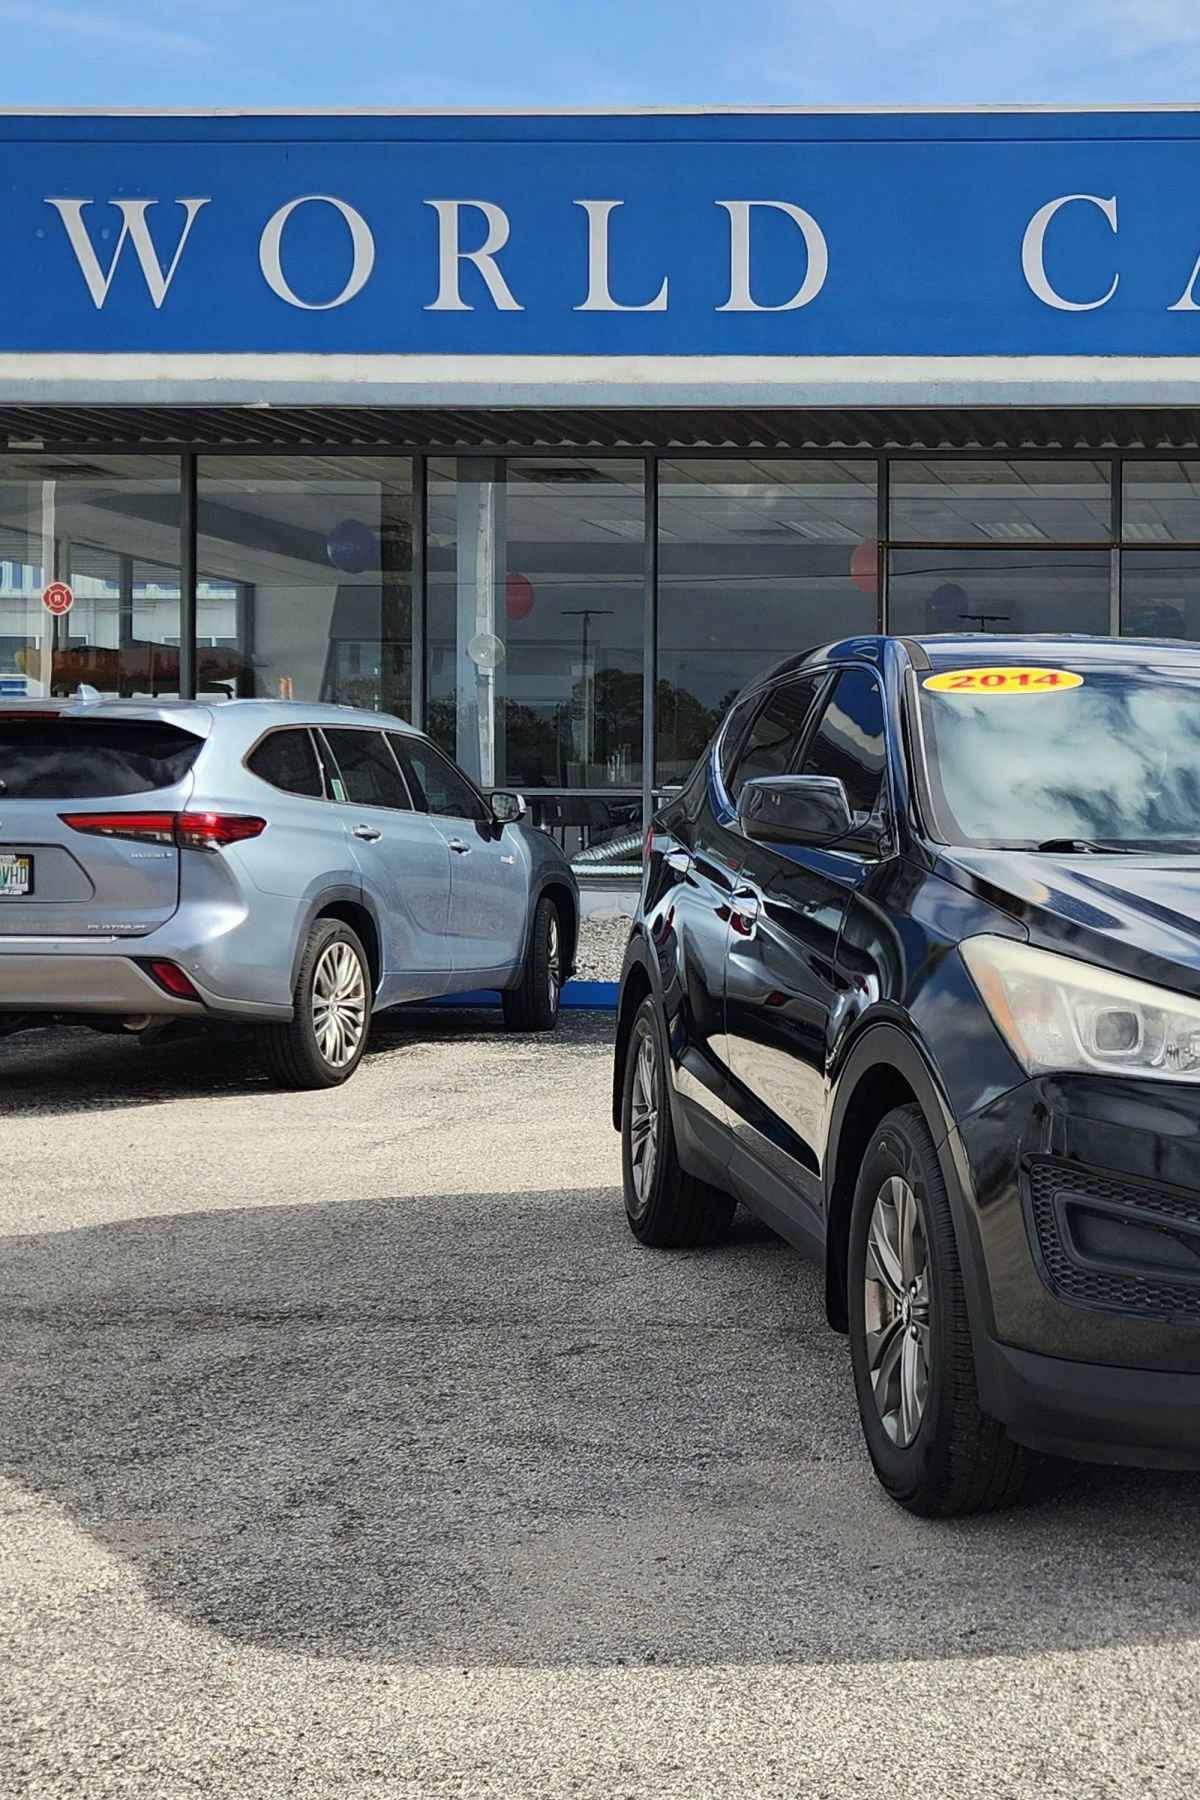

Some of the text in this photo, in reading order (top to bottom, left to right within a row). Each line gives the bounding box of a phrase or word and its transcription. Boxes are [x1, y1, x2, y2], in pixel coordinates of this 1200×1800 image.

[43, 194, 828, 311] WORLD
[949, 674, 1061, 688] 2014
[0, 865, 28, 885] VHD
